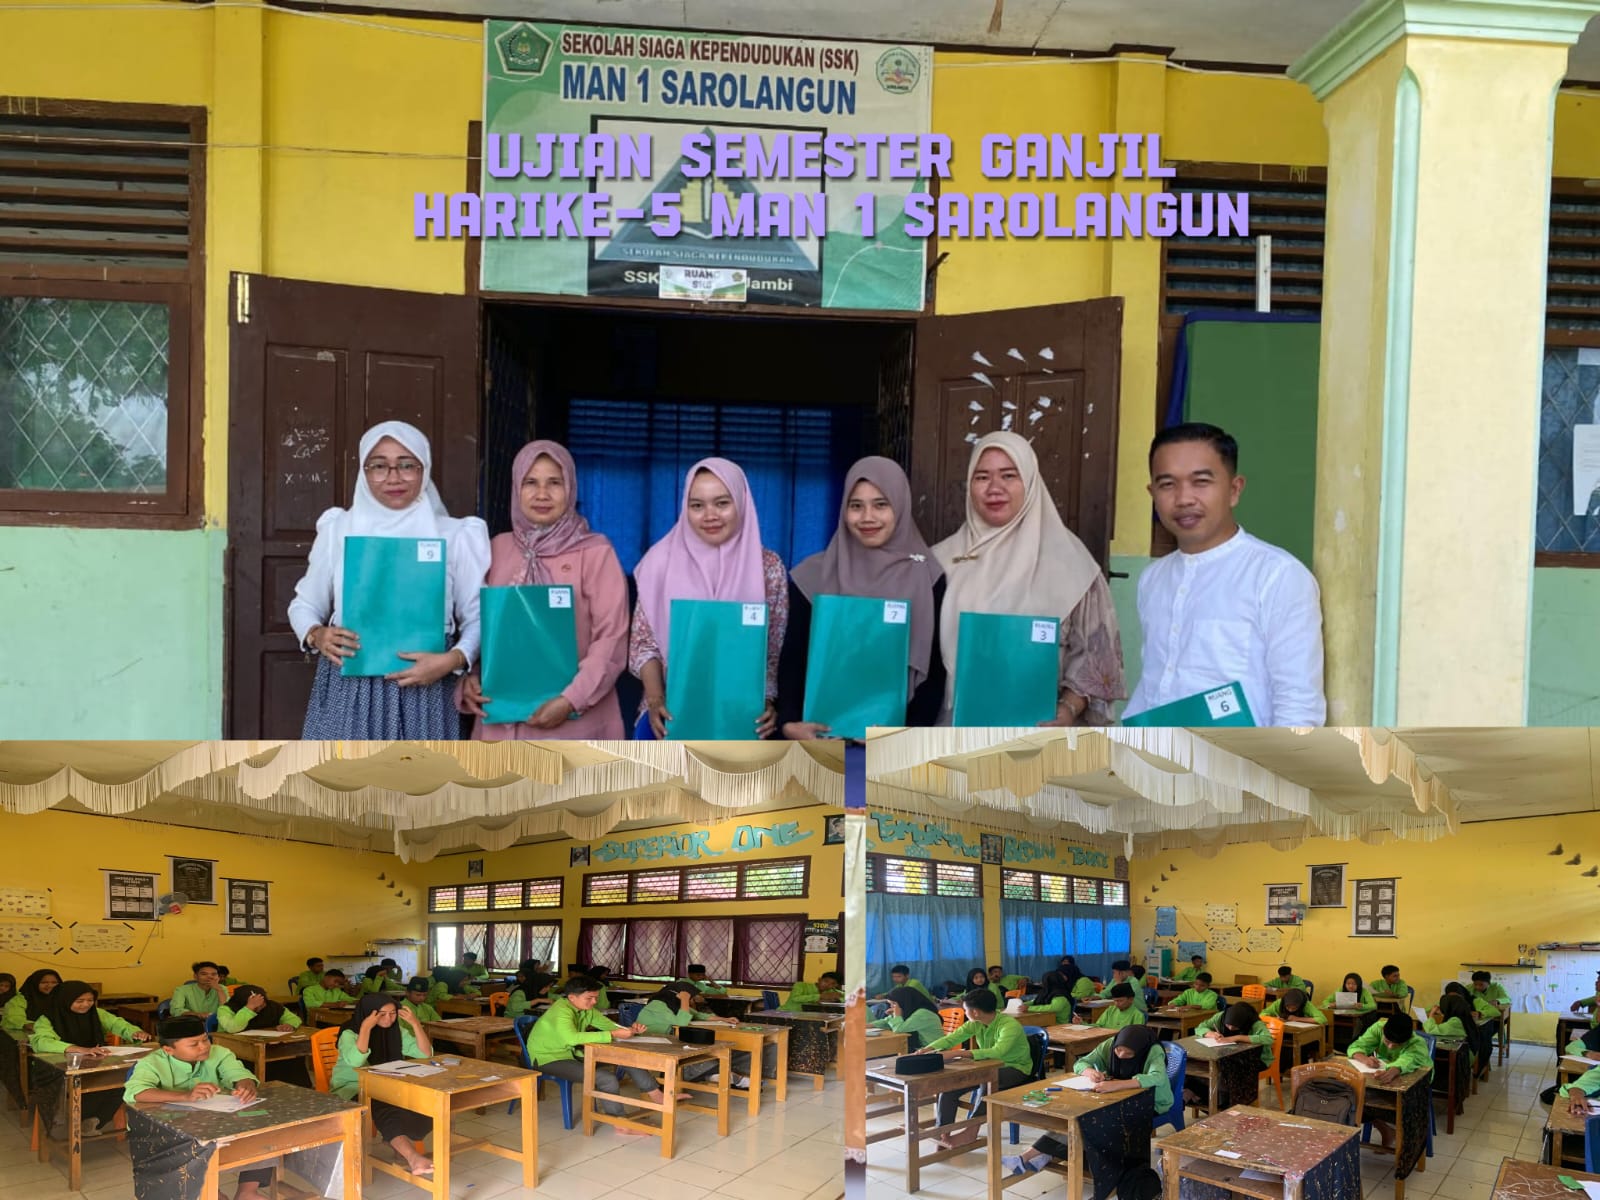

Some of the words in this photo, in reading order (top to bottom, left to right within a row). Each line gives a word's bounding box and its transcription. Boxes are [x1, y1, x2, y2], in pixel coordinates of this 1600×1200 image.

[561, 31, 635, 57] SEKOLAH
[638, 36, 686, 61] SIAGA
[689, 39, 816, 68] KEPENDUDUKAN
[819, 48, 859, 74] (SSK)
[562, 63, 627, 102] MAN
[636, 67, 650, 103] 1
[661, 69, 857, 116] SAROLANGUN
[623, 270, 660, 285] SSK
[426, 550, 435, 560] 9
[1039, 630, 1048, 641] 3
[1220, 700, 1231, 713] 6
